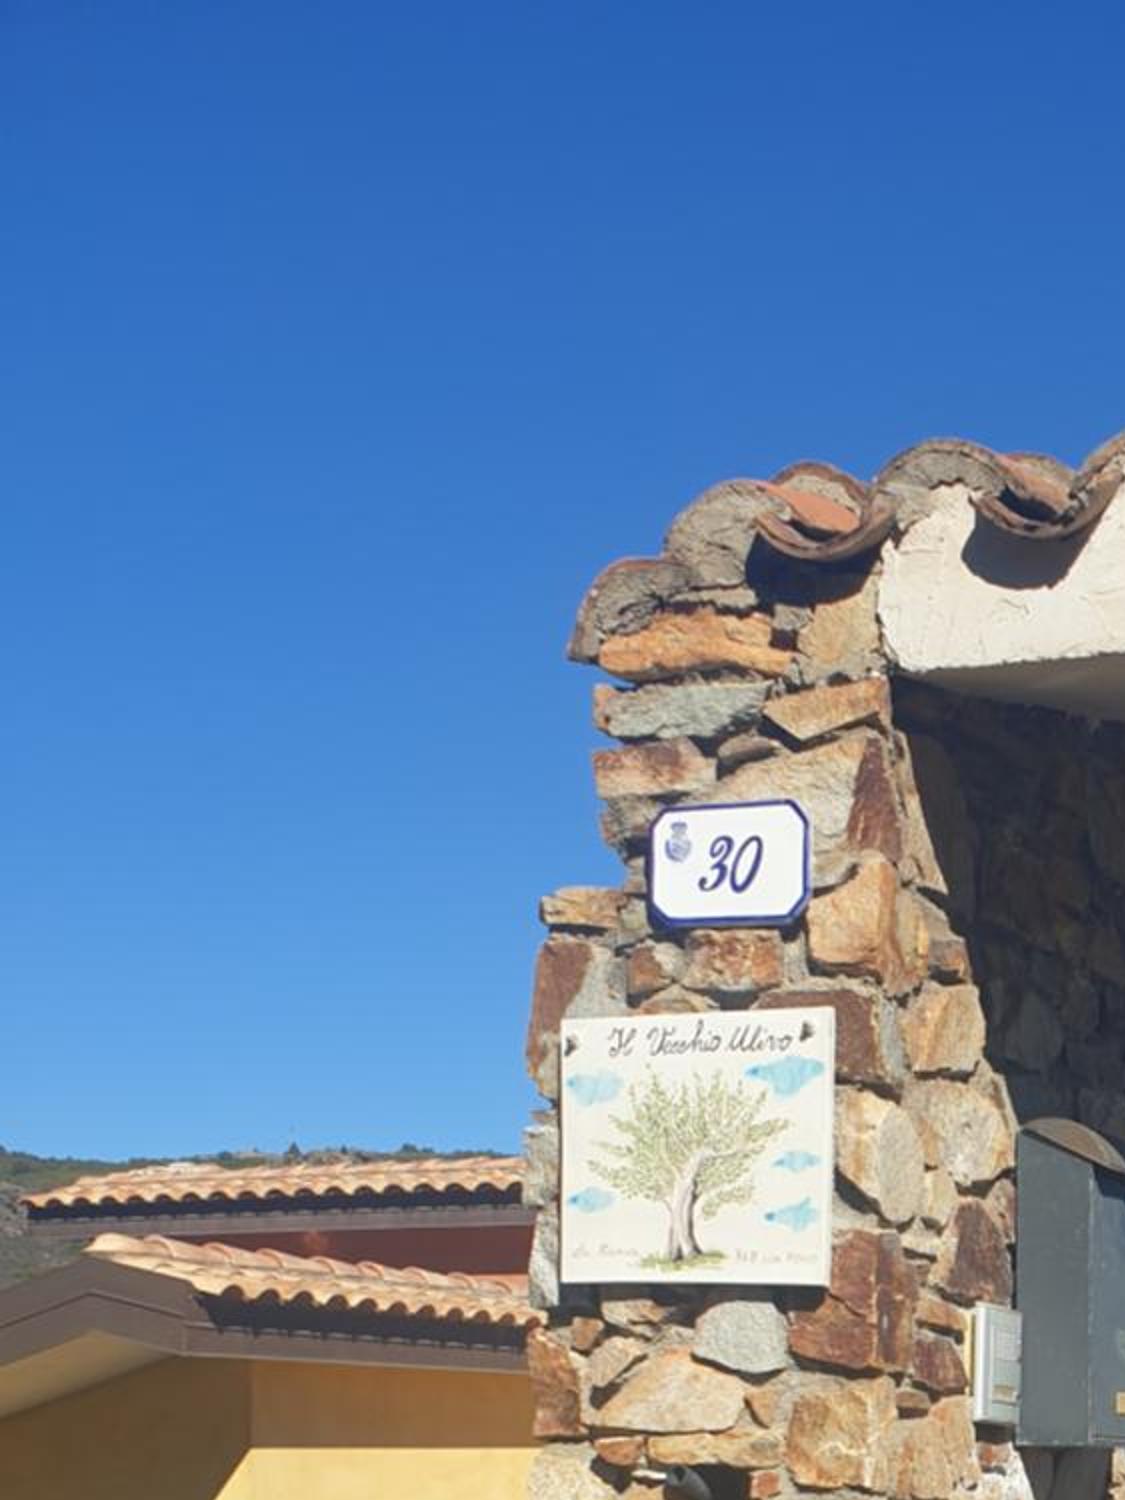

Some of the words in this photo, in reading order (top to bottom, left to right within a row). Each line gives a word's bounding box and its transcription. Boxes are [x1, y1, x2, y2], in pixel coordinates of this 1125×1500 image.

[698, 835, 764, 894] 30
[607, 1027, 637, 1058] Il
[646, 1019, 722, 1057] Vecchio
[726, 1024, 792, 1053] Ulivo
